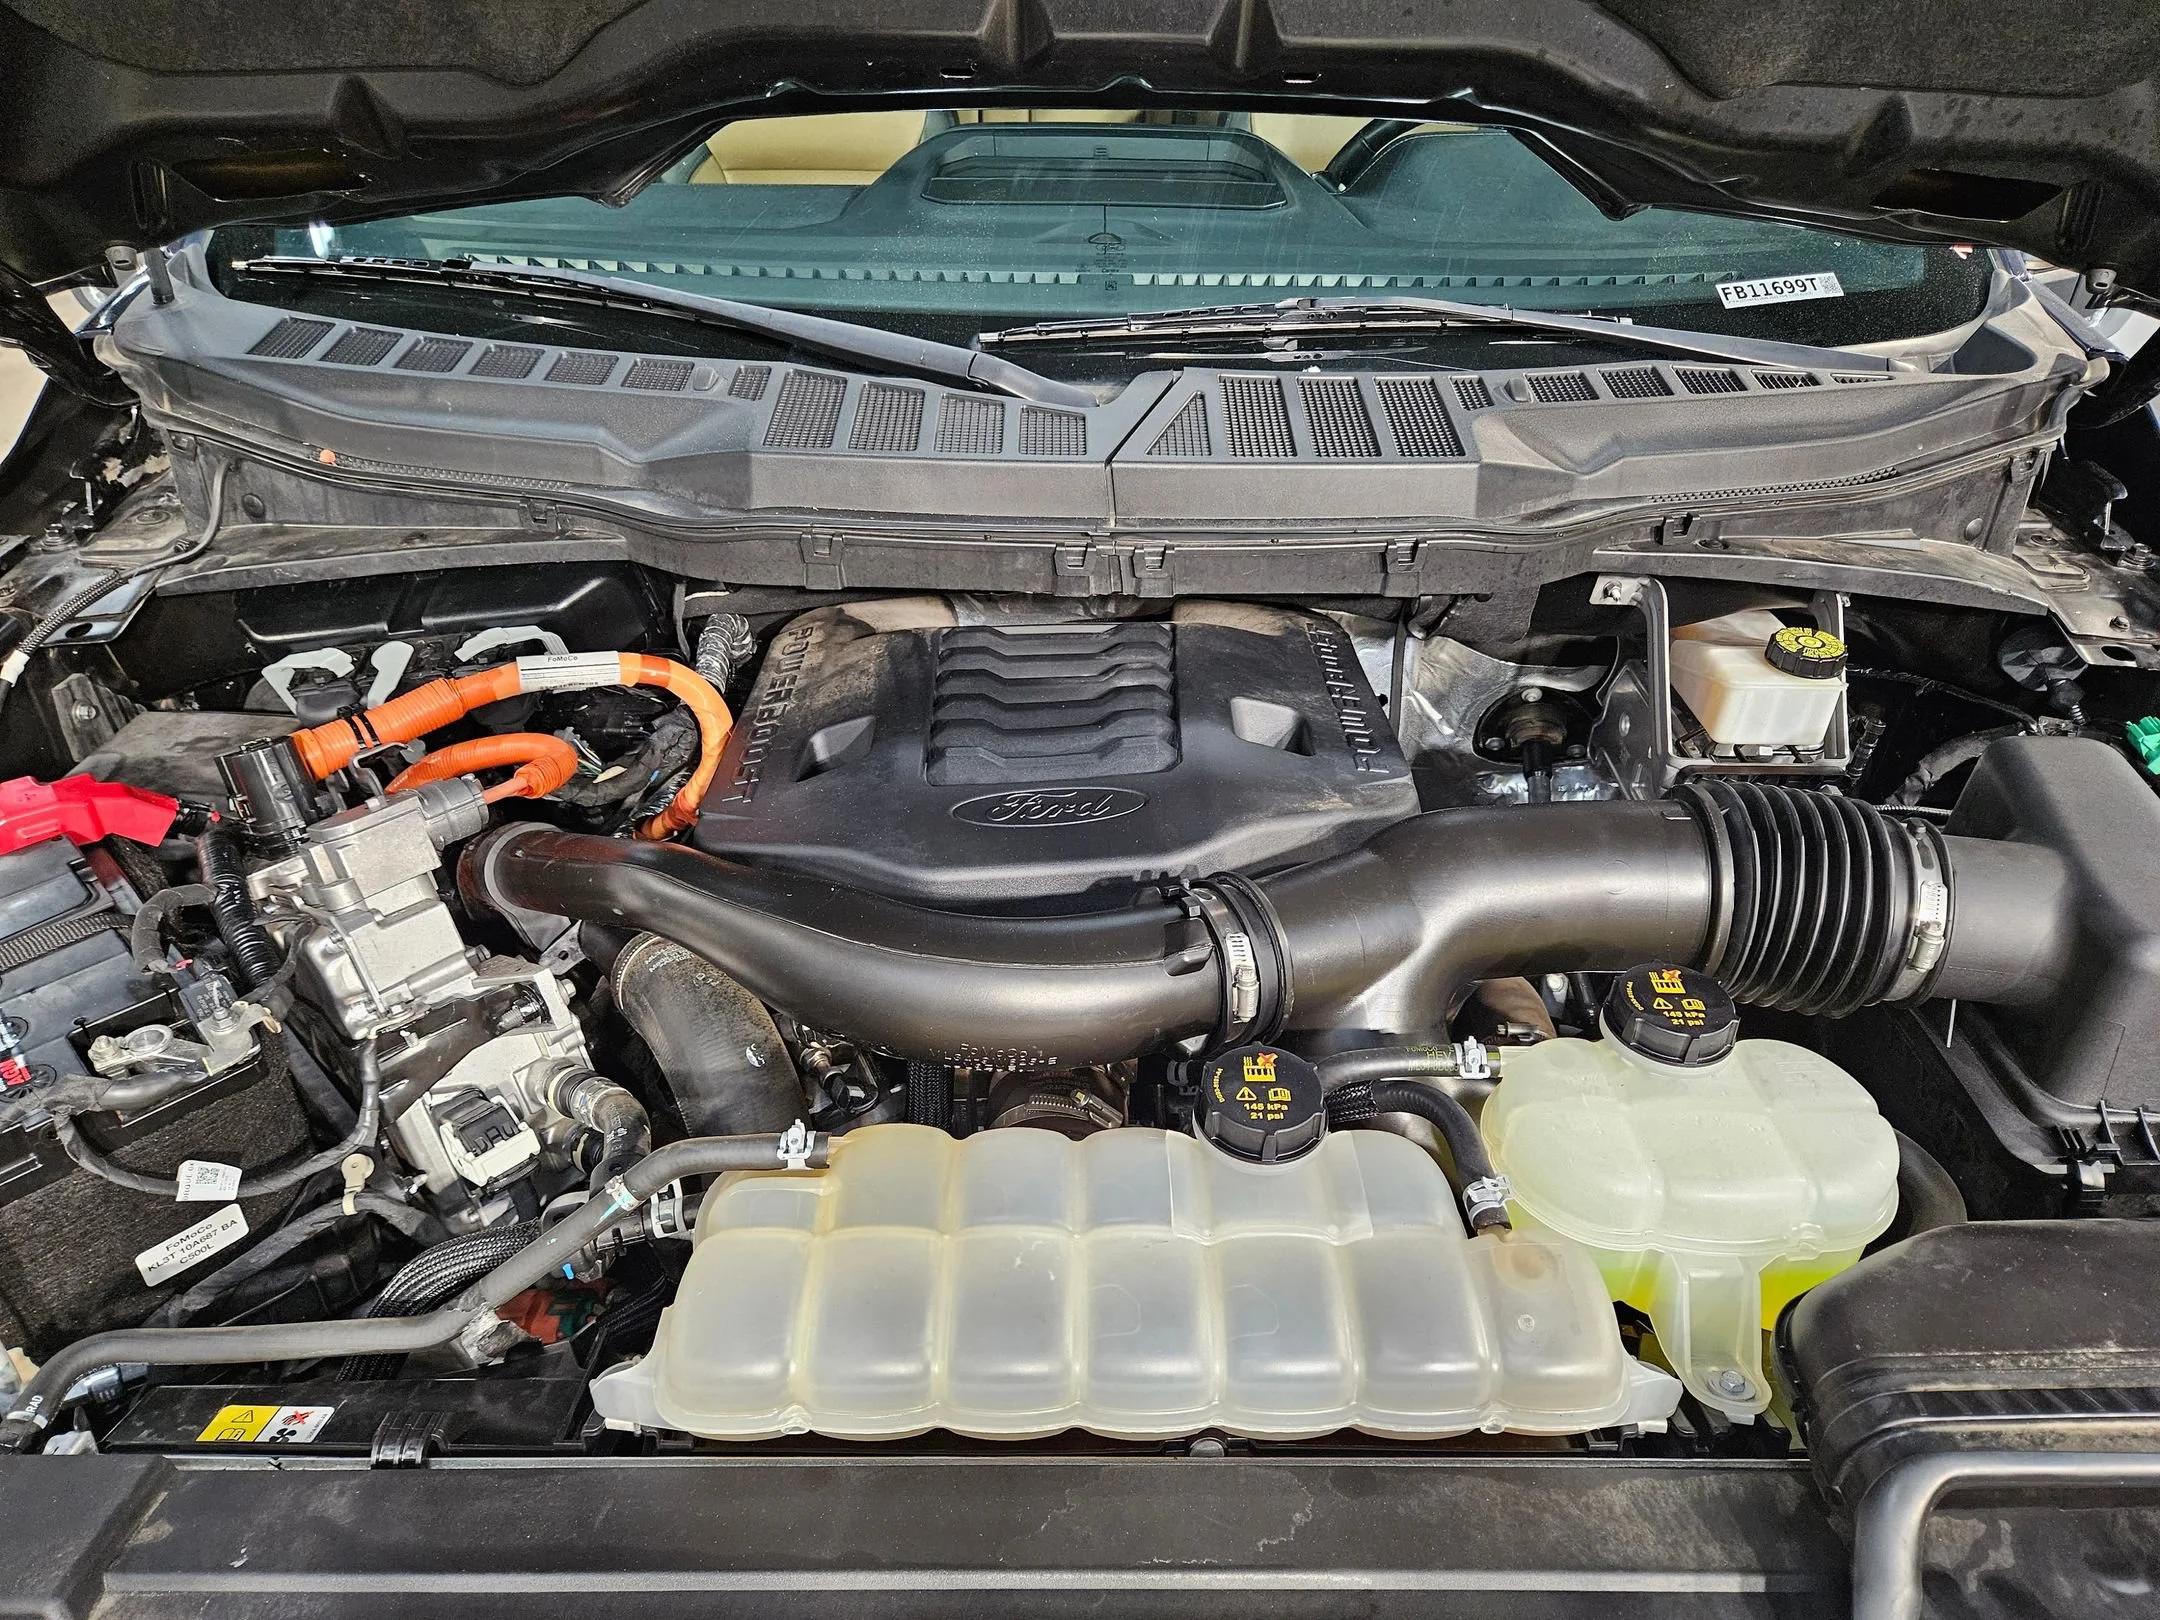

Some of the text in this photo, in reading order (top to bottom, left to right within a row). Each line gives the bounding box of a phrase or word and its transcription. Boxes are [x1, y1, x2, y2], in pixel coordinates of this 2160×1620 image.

[1721, 277, 1817, 301] FB11699T
[721, 625, 817, 804] POWERBOOST
[986, 791, 1114, 822] Ford
[1684, 1011, 1706, 1019] kPa
[1426, 1050, 1452, 1061] HEV
[1266, 1103, 1289, 1111] kPa
[1267, 1112, 1284, 1120] psi
[147, 1219, 239, 1272] KL3T 10A687 BA
[165, 1223, 213, 1252] FoMoCo
[179, 1243, 215, 1265] C500L
[25, 1394, 44, 1413] RAD
